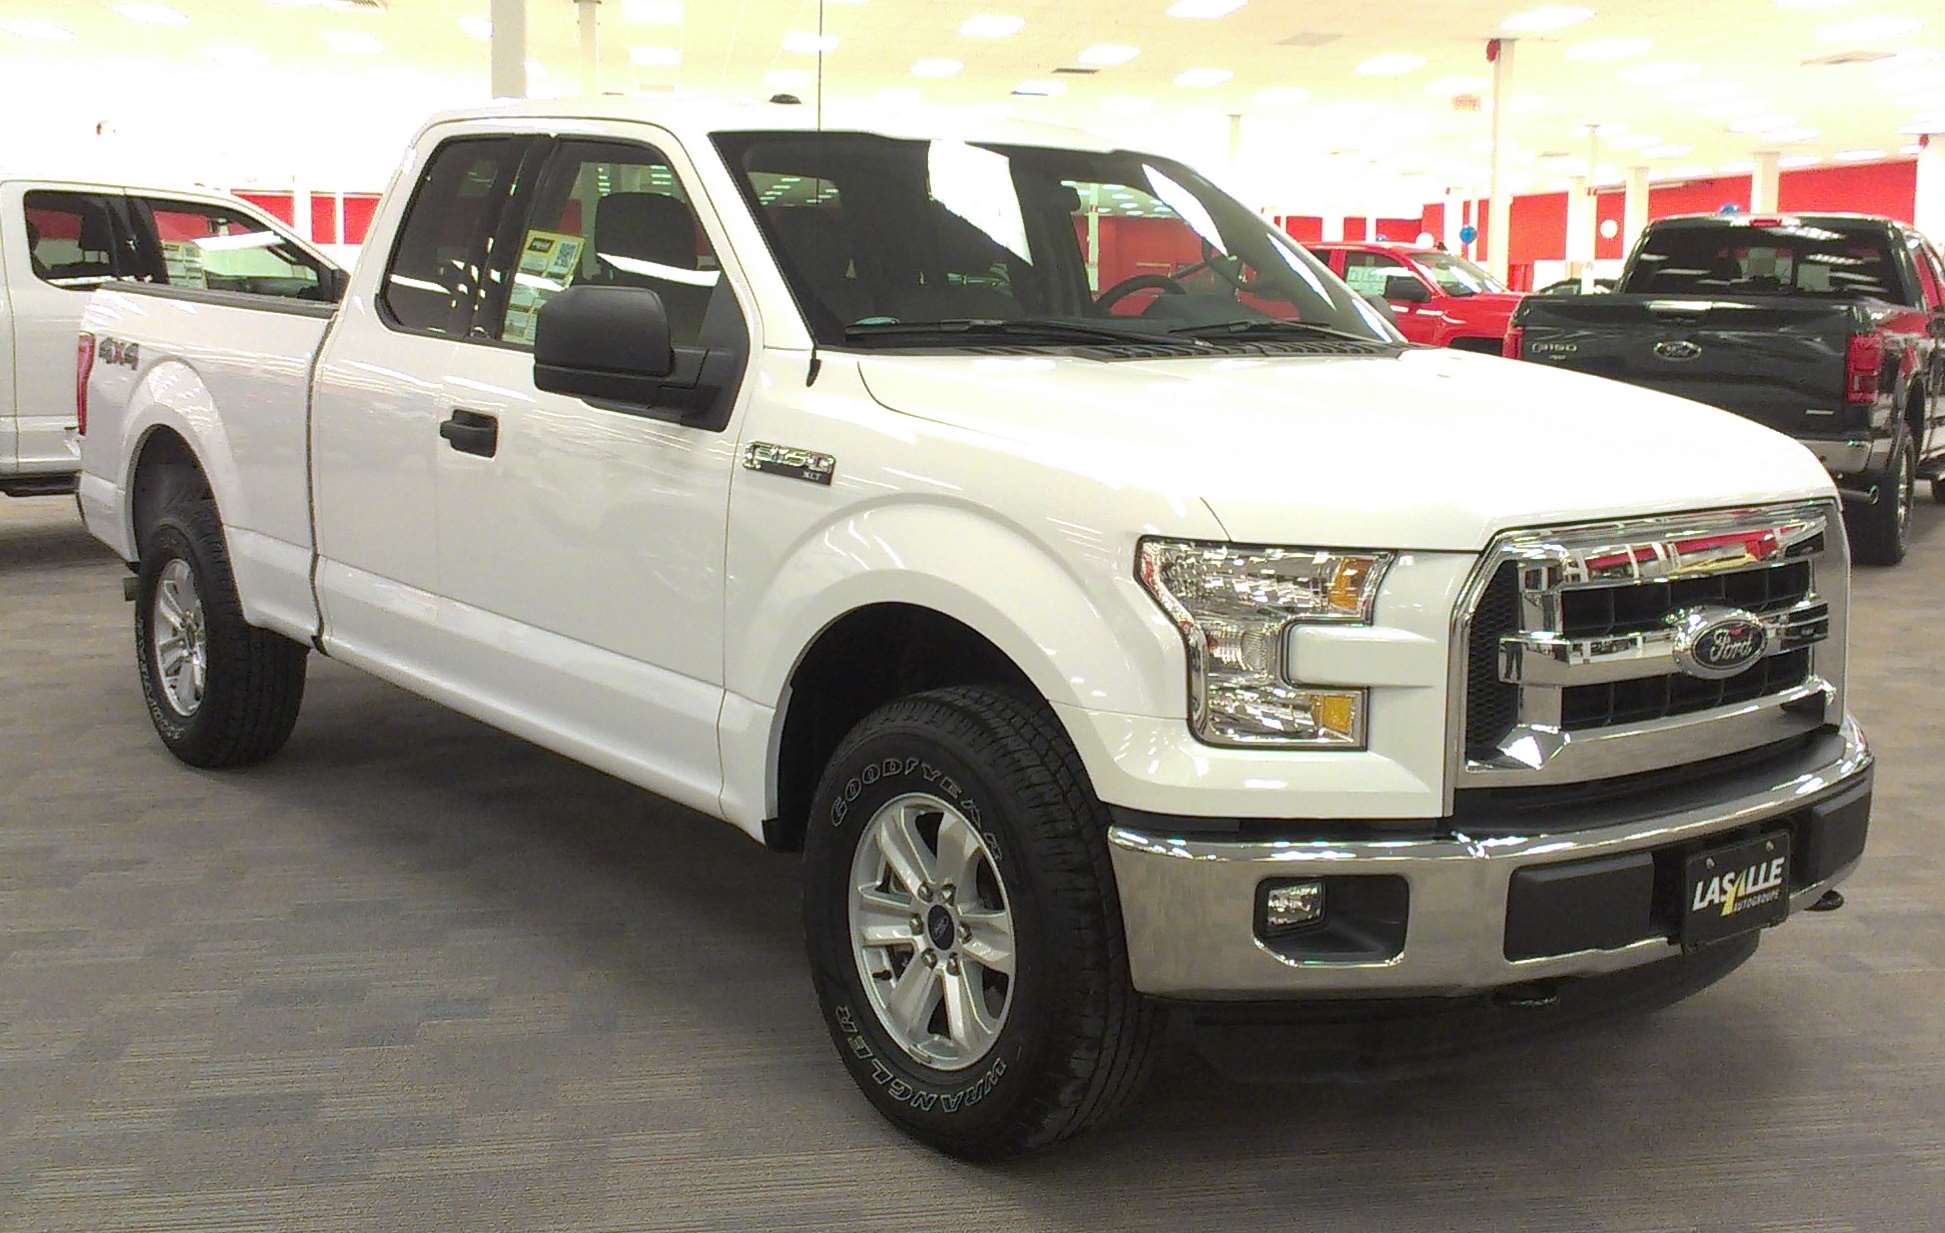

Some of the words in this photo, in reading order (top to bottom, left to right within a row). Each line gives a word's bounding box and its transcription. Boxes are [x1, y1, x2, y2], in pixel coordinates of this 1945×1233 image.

[1710, 627, 1754, 662] Ford
[831, 757, 1002, 861] GOODYEAR
[835, 1005, 1007, 1113] WRANGLER
